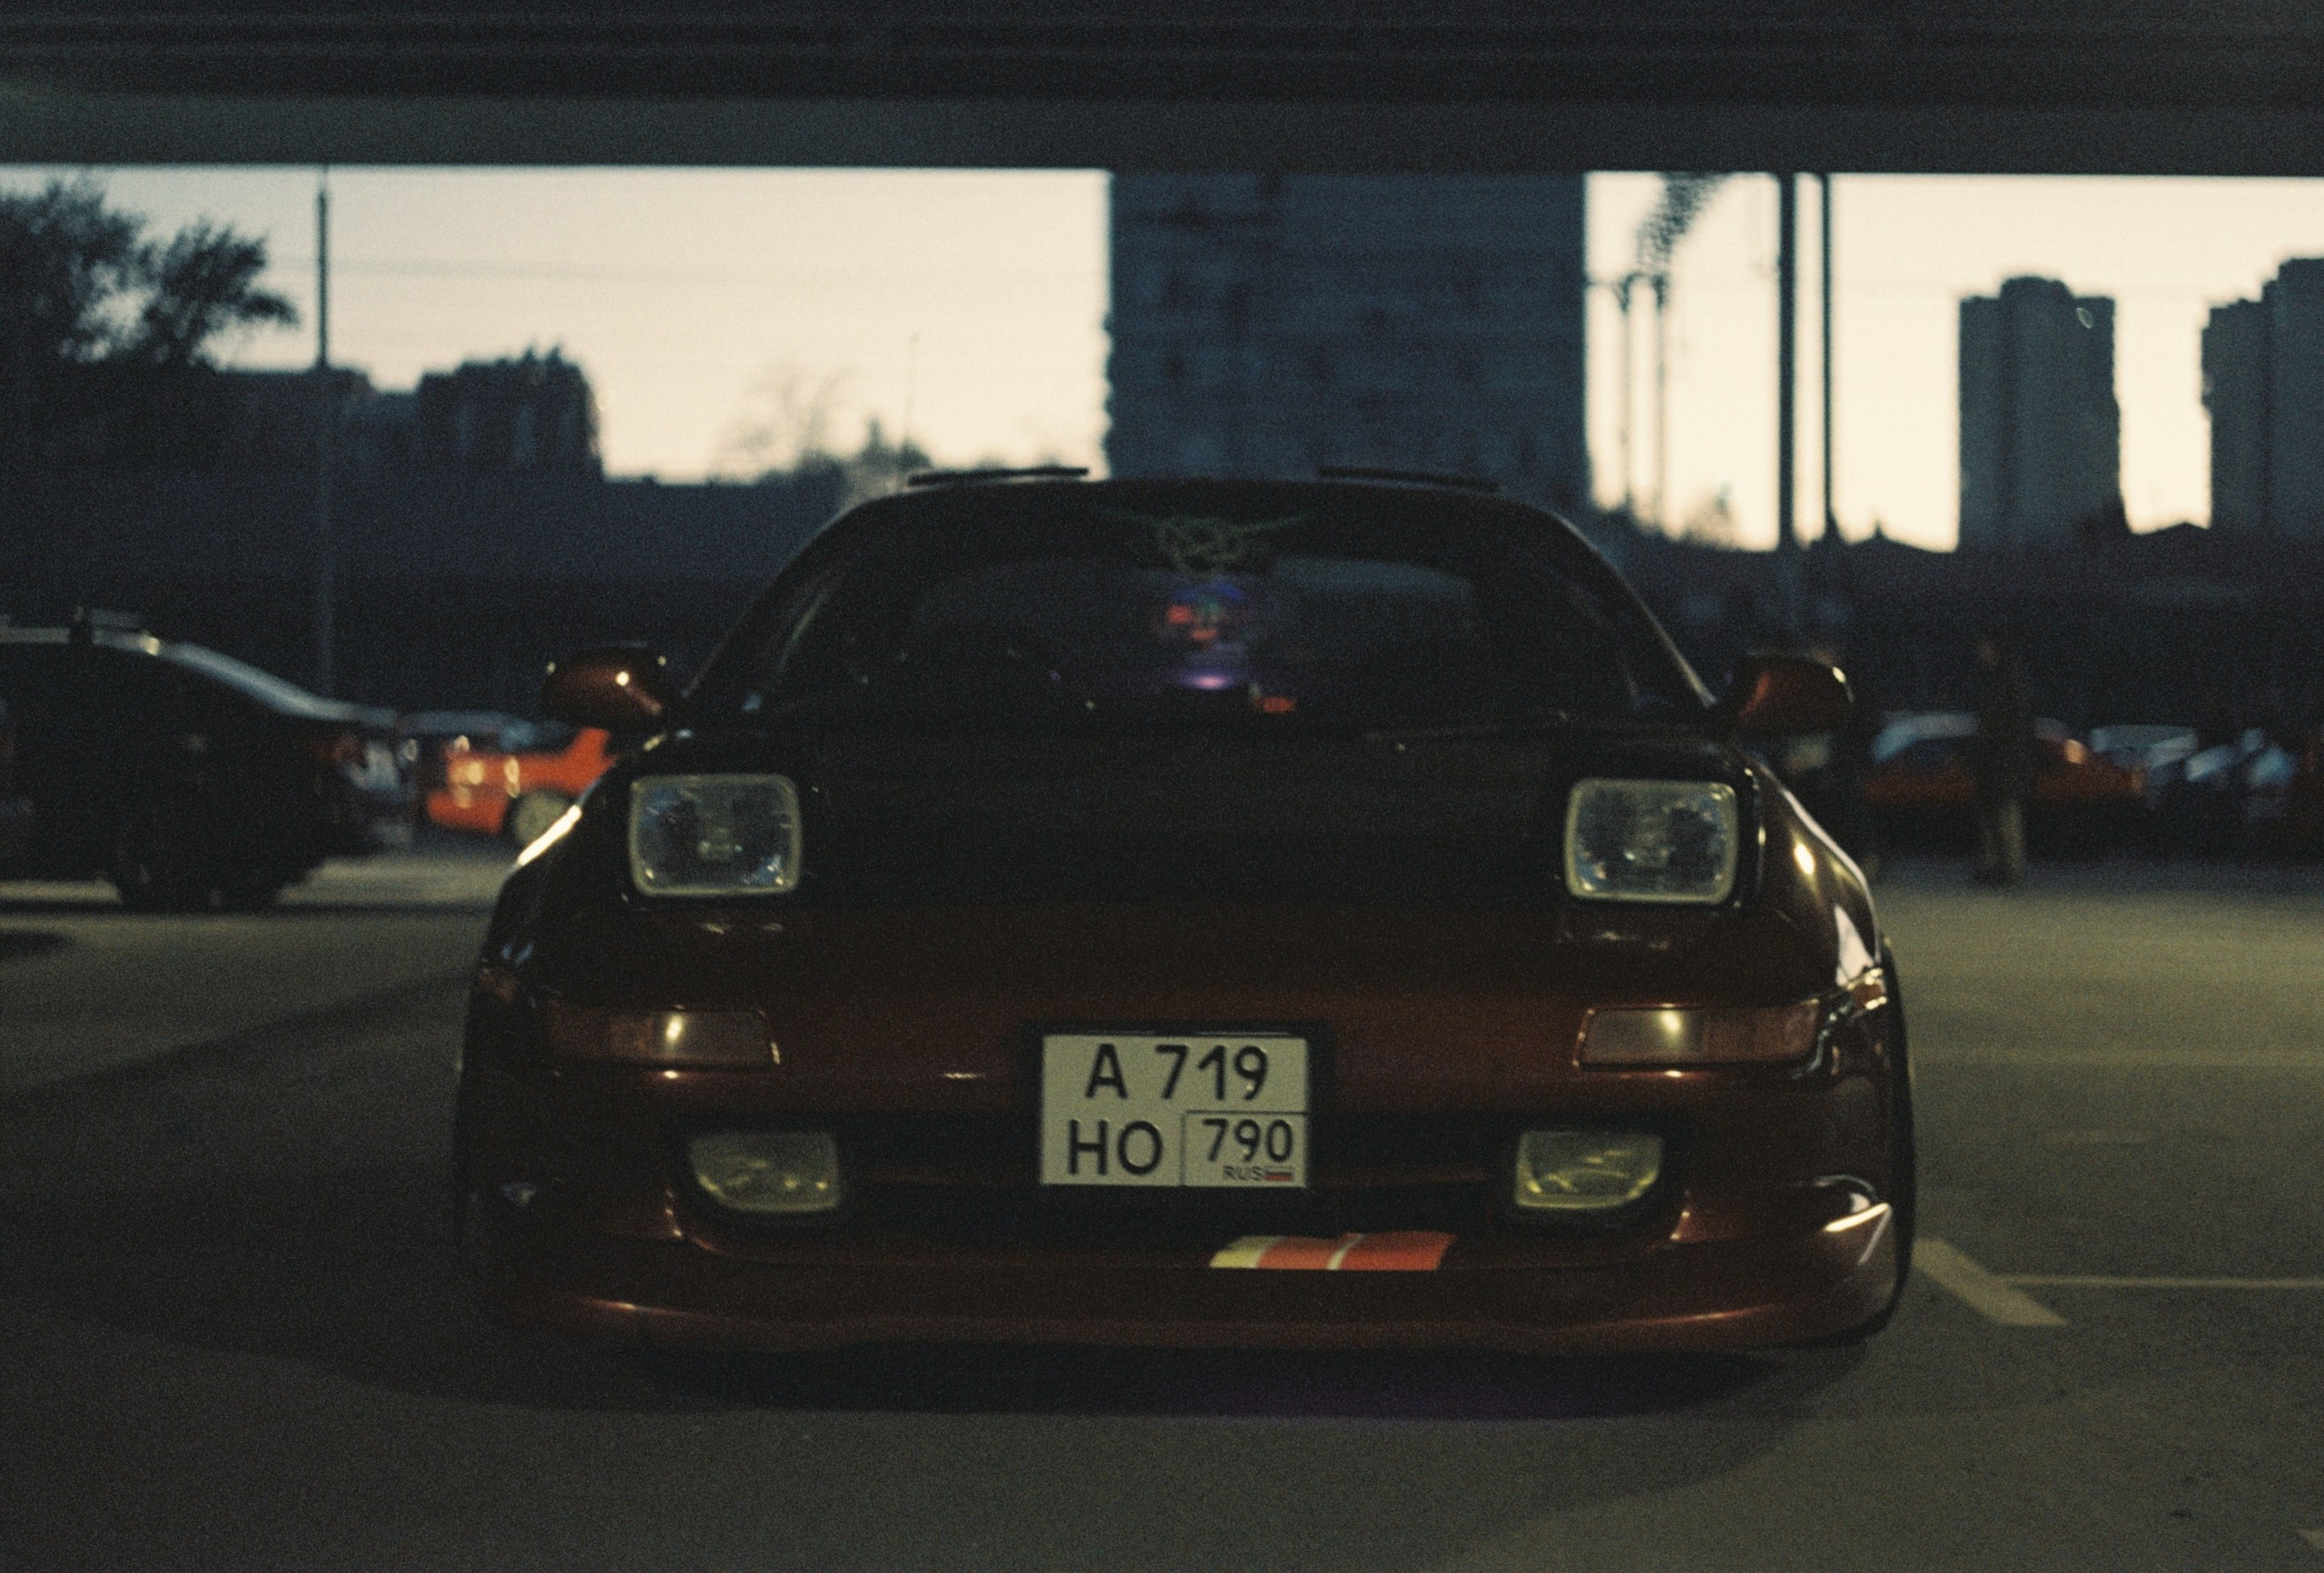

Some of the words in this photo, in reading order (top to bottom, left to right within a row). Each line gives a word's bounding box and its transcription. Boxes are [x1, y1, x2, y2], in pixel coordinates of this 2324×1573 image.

[1155, 1044, 1268, 1101] 719
[1203, 1118, 1294, 1163] 790
[1223, 1165, 1265, 1181] RUS
